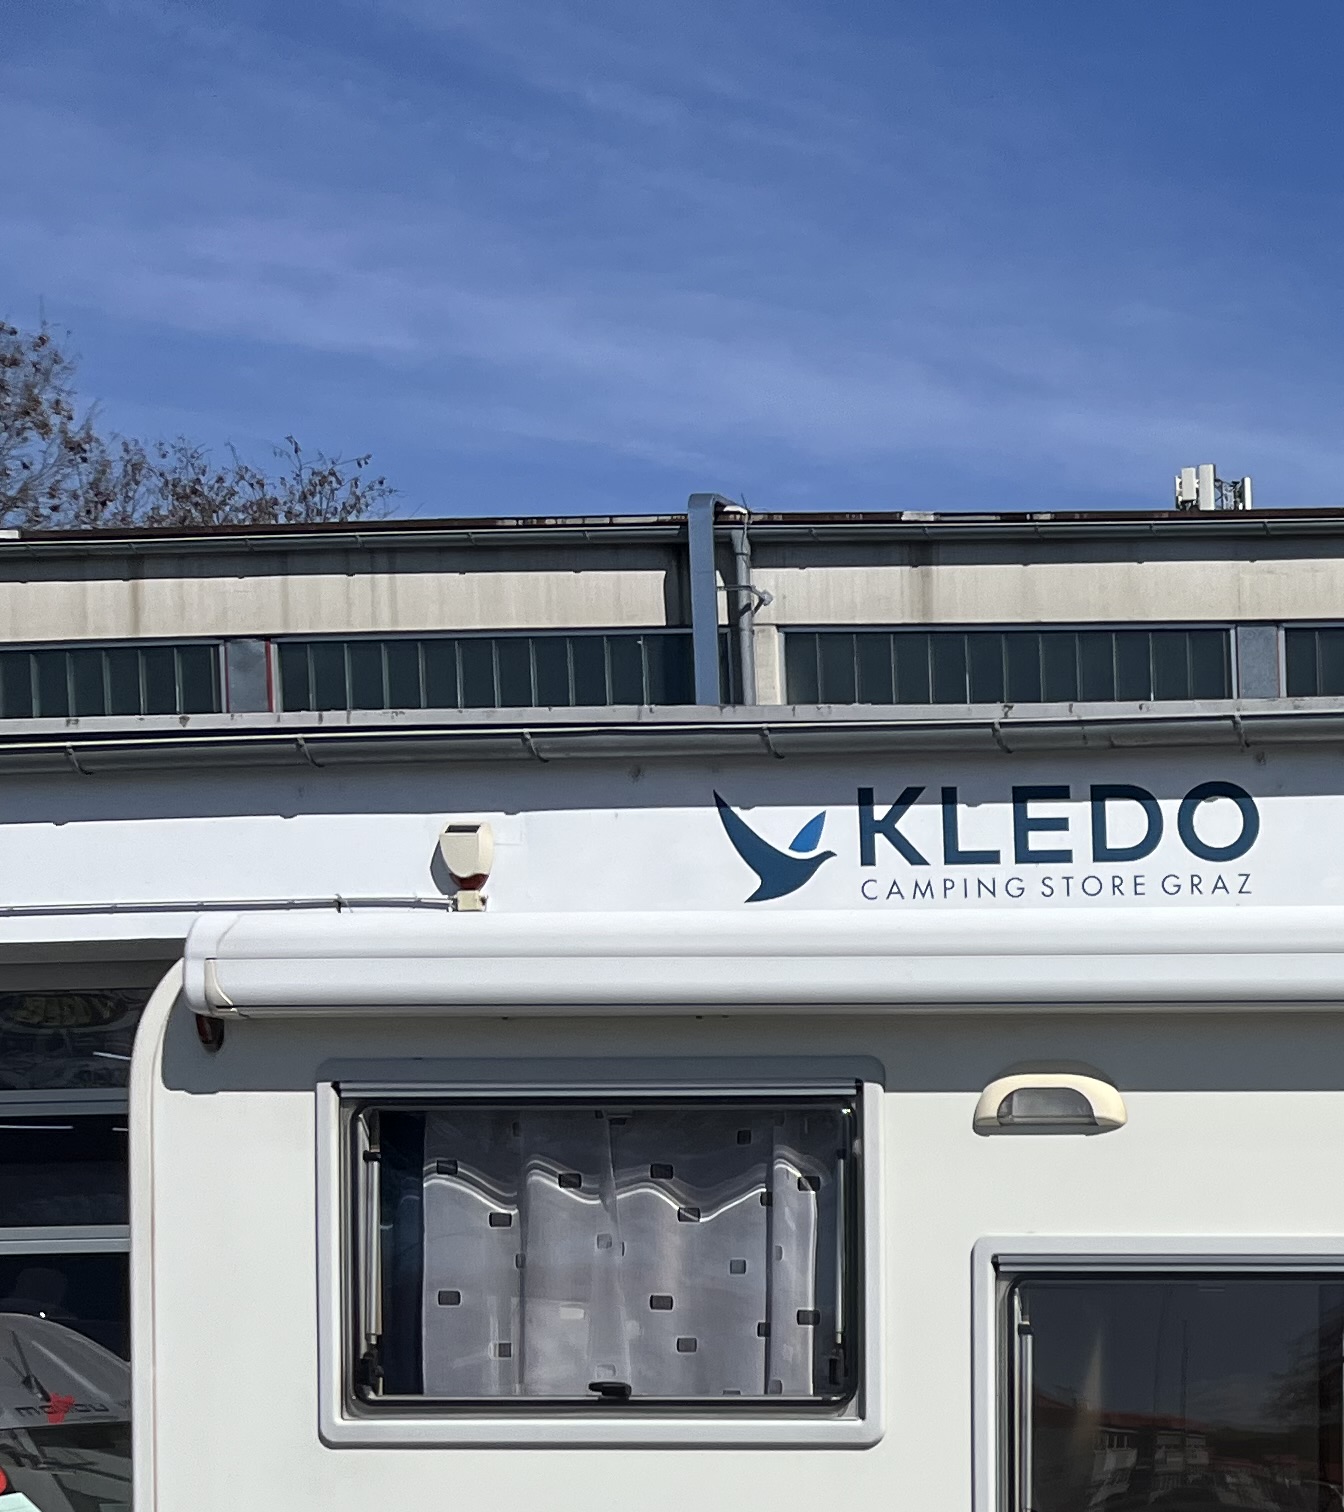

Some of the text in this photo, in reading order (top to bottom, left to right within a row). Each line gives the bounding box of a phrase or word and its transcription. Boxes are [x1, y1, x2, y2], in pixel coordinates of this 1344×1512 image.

[857, 781, 1260, 867] KLEDO
[861, 872, 1253, 901] CAMPING STORE GRAZ
